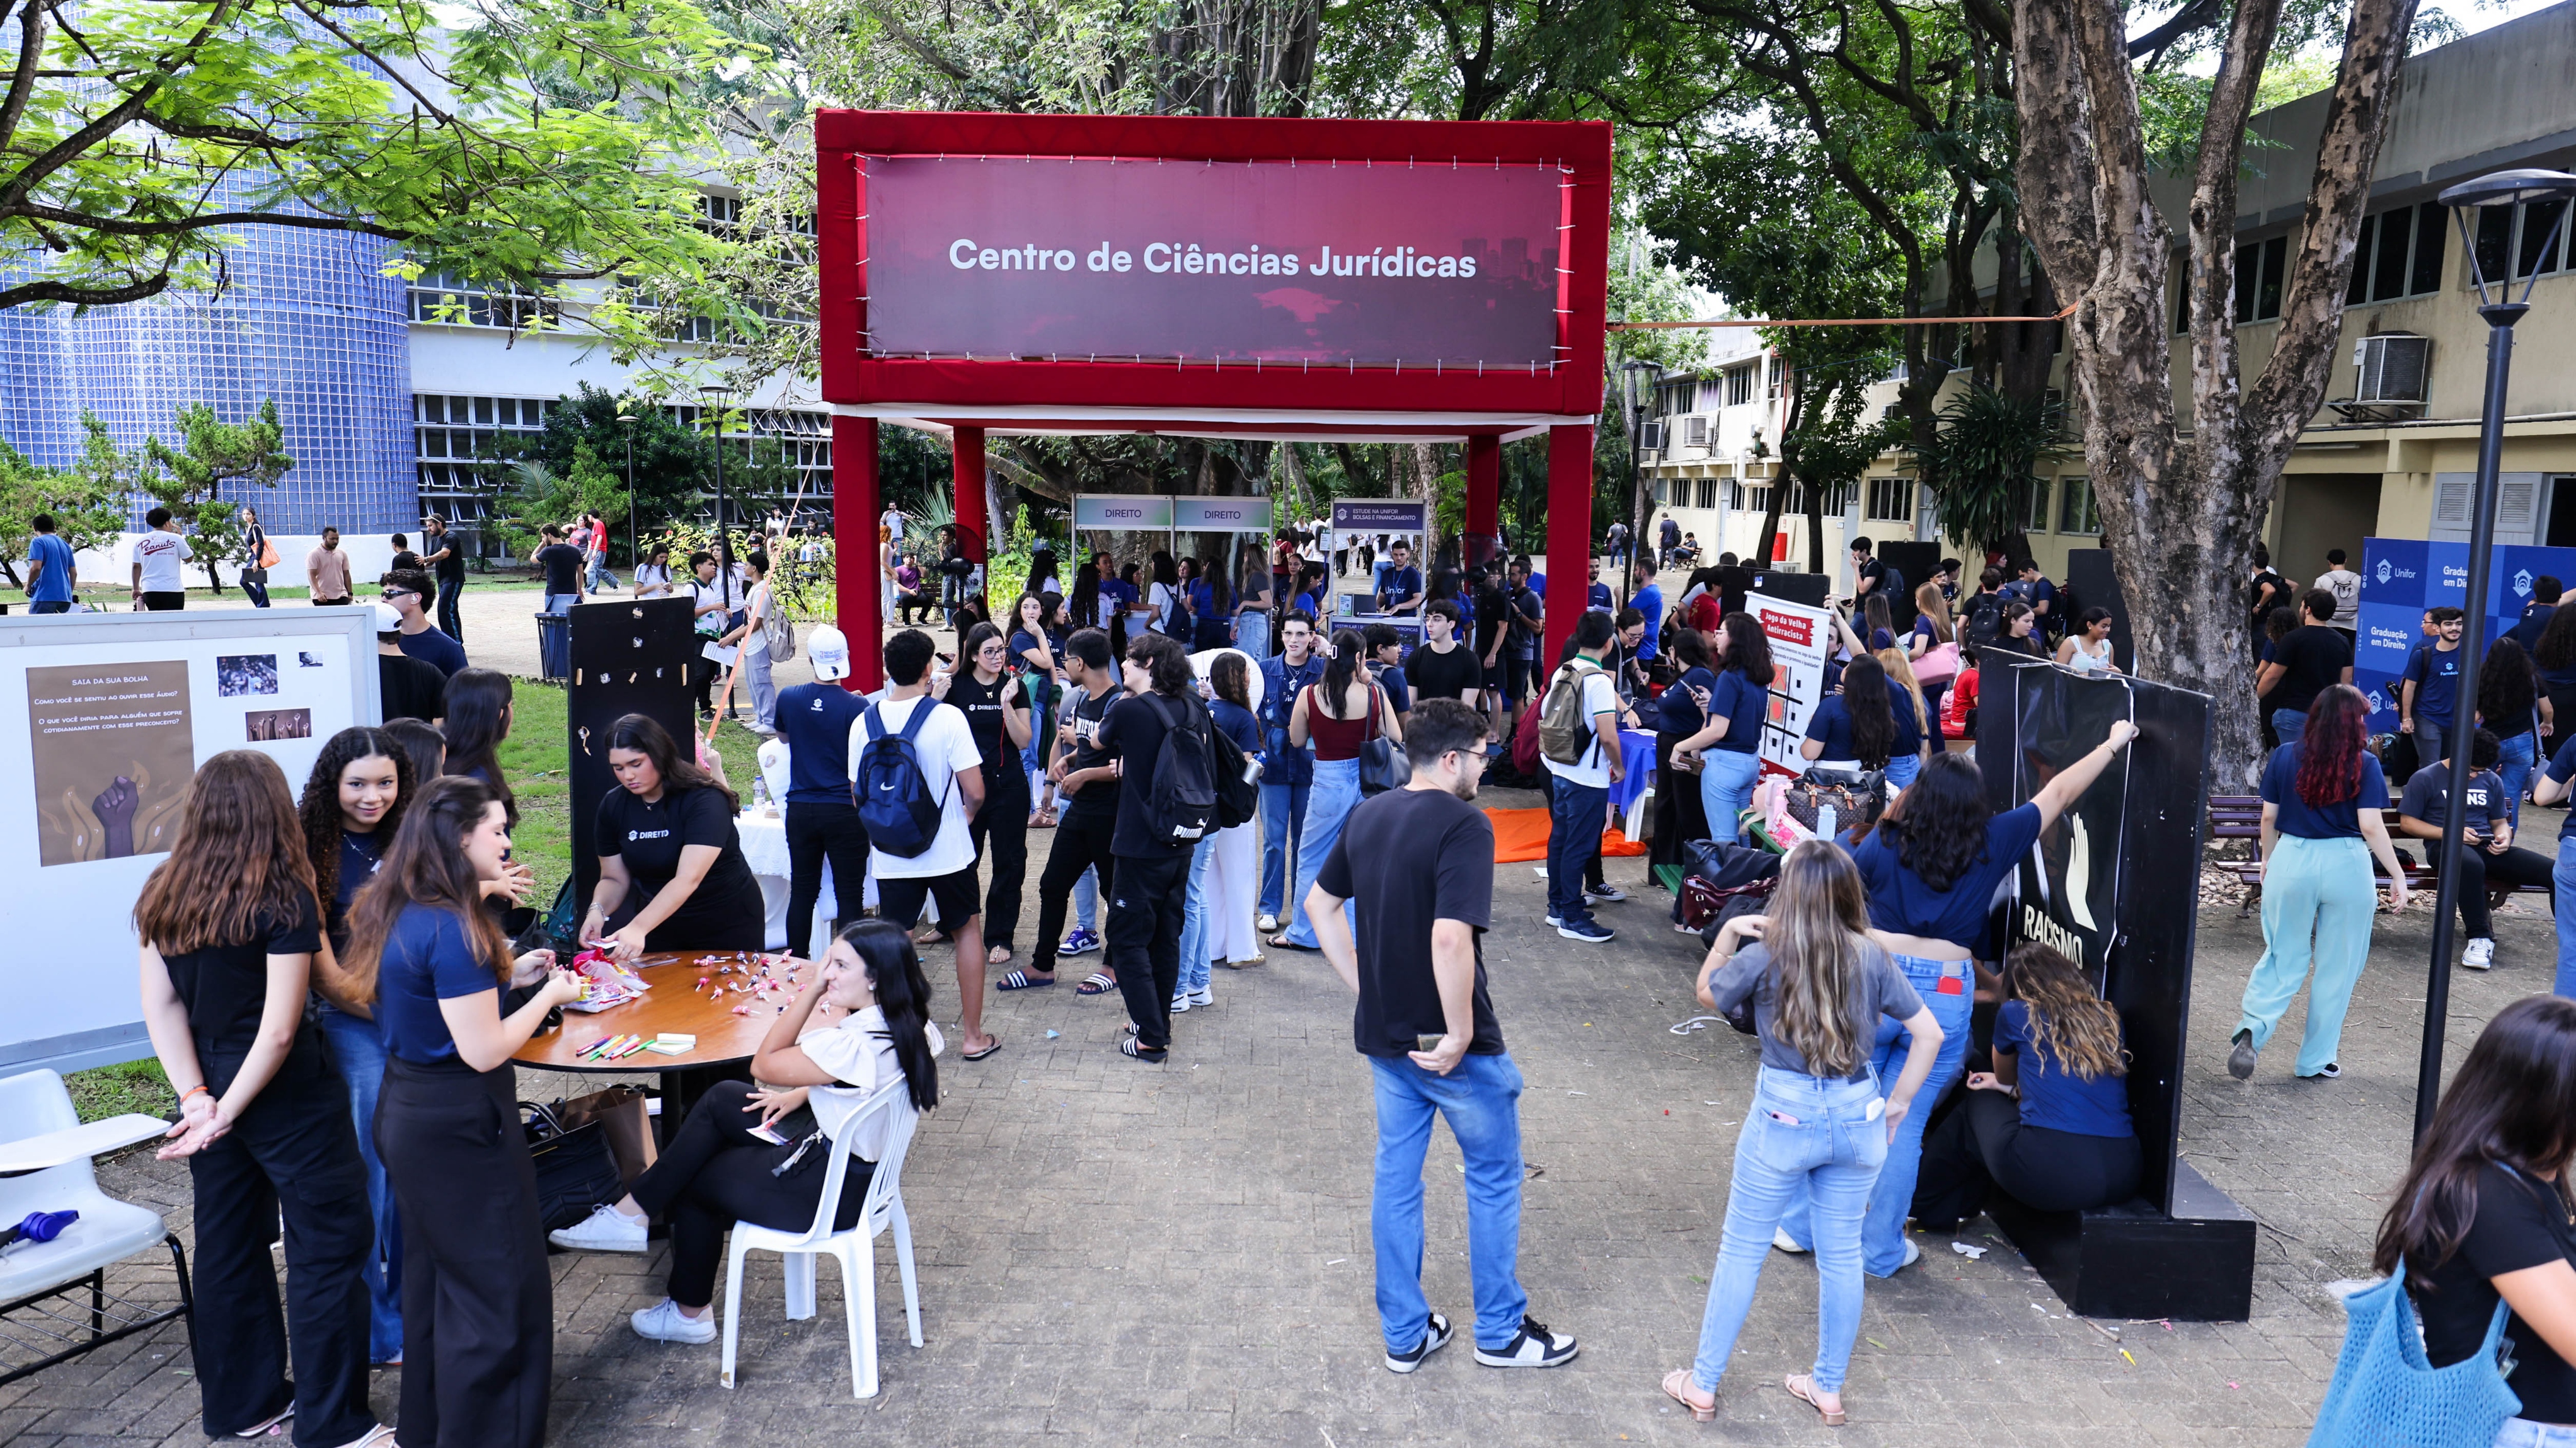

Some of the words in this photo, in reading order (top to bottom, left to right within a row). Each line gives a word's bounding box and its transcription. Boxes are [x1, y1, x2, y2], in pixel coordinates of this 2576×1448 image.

[949, 238, 1076, 272] Centro
[1087, 241, 1132, 273] de
[1143, 242, 1299, 276] Ciências
[1309, 244, 1476, 278] Jurídicas
[1105, 509, 1142, 518] DIREITO
[1204, 510, 1241, 519] DIREITO
[138, 539, 176, 553] Peanuts
[2395, 568, 2416, 578] Unifor
[1766, 612, 1778, 623] Jogo
[1788, 618, 1807, 629] Velha
[1766, 624, 1803, 641] Antirracista
[2371, 626, 2408, 641] Graduação
[2383, 638, 2406, 650] Direito
[120, 711, 147, 720] ALGUÉM
[43, 724, 100, 734] COTIDIANAMENTE
[135, 718, 180, 728] PRECONCEITO?
[639, 829, 669, 839] DIREITO
[1172, 824, 1203, 839] PUMA
[2023, 904, 2083, 970] RACISMO
